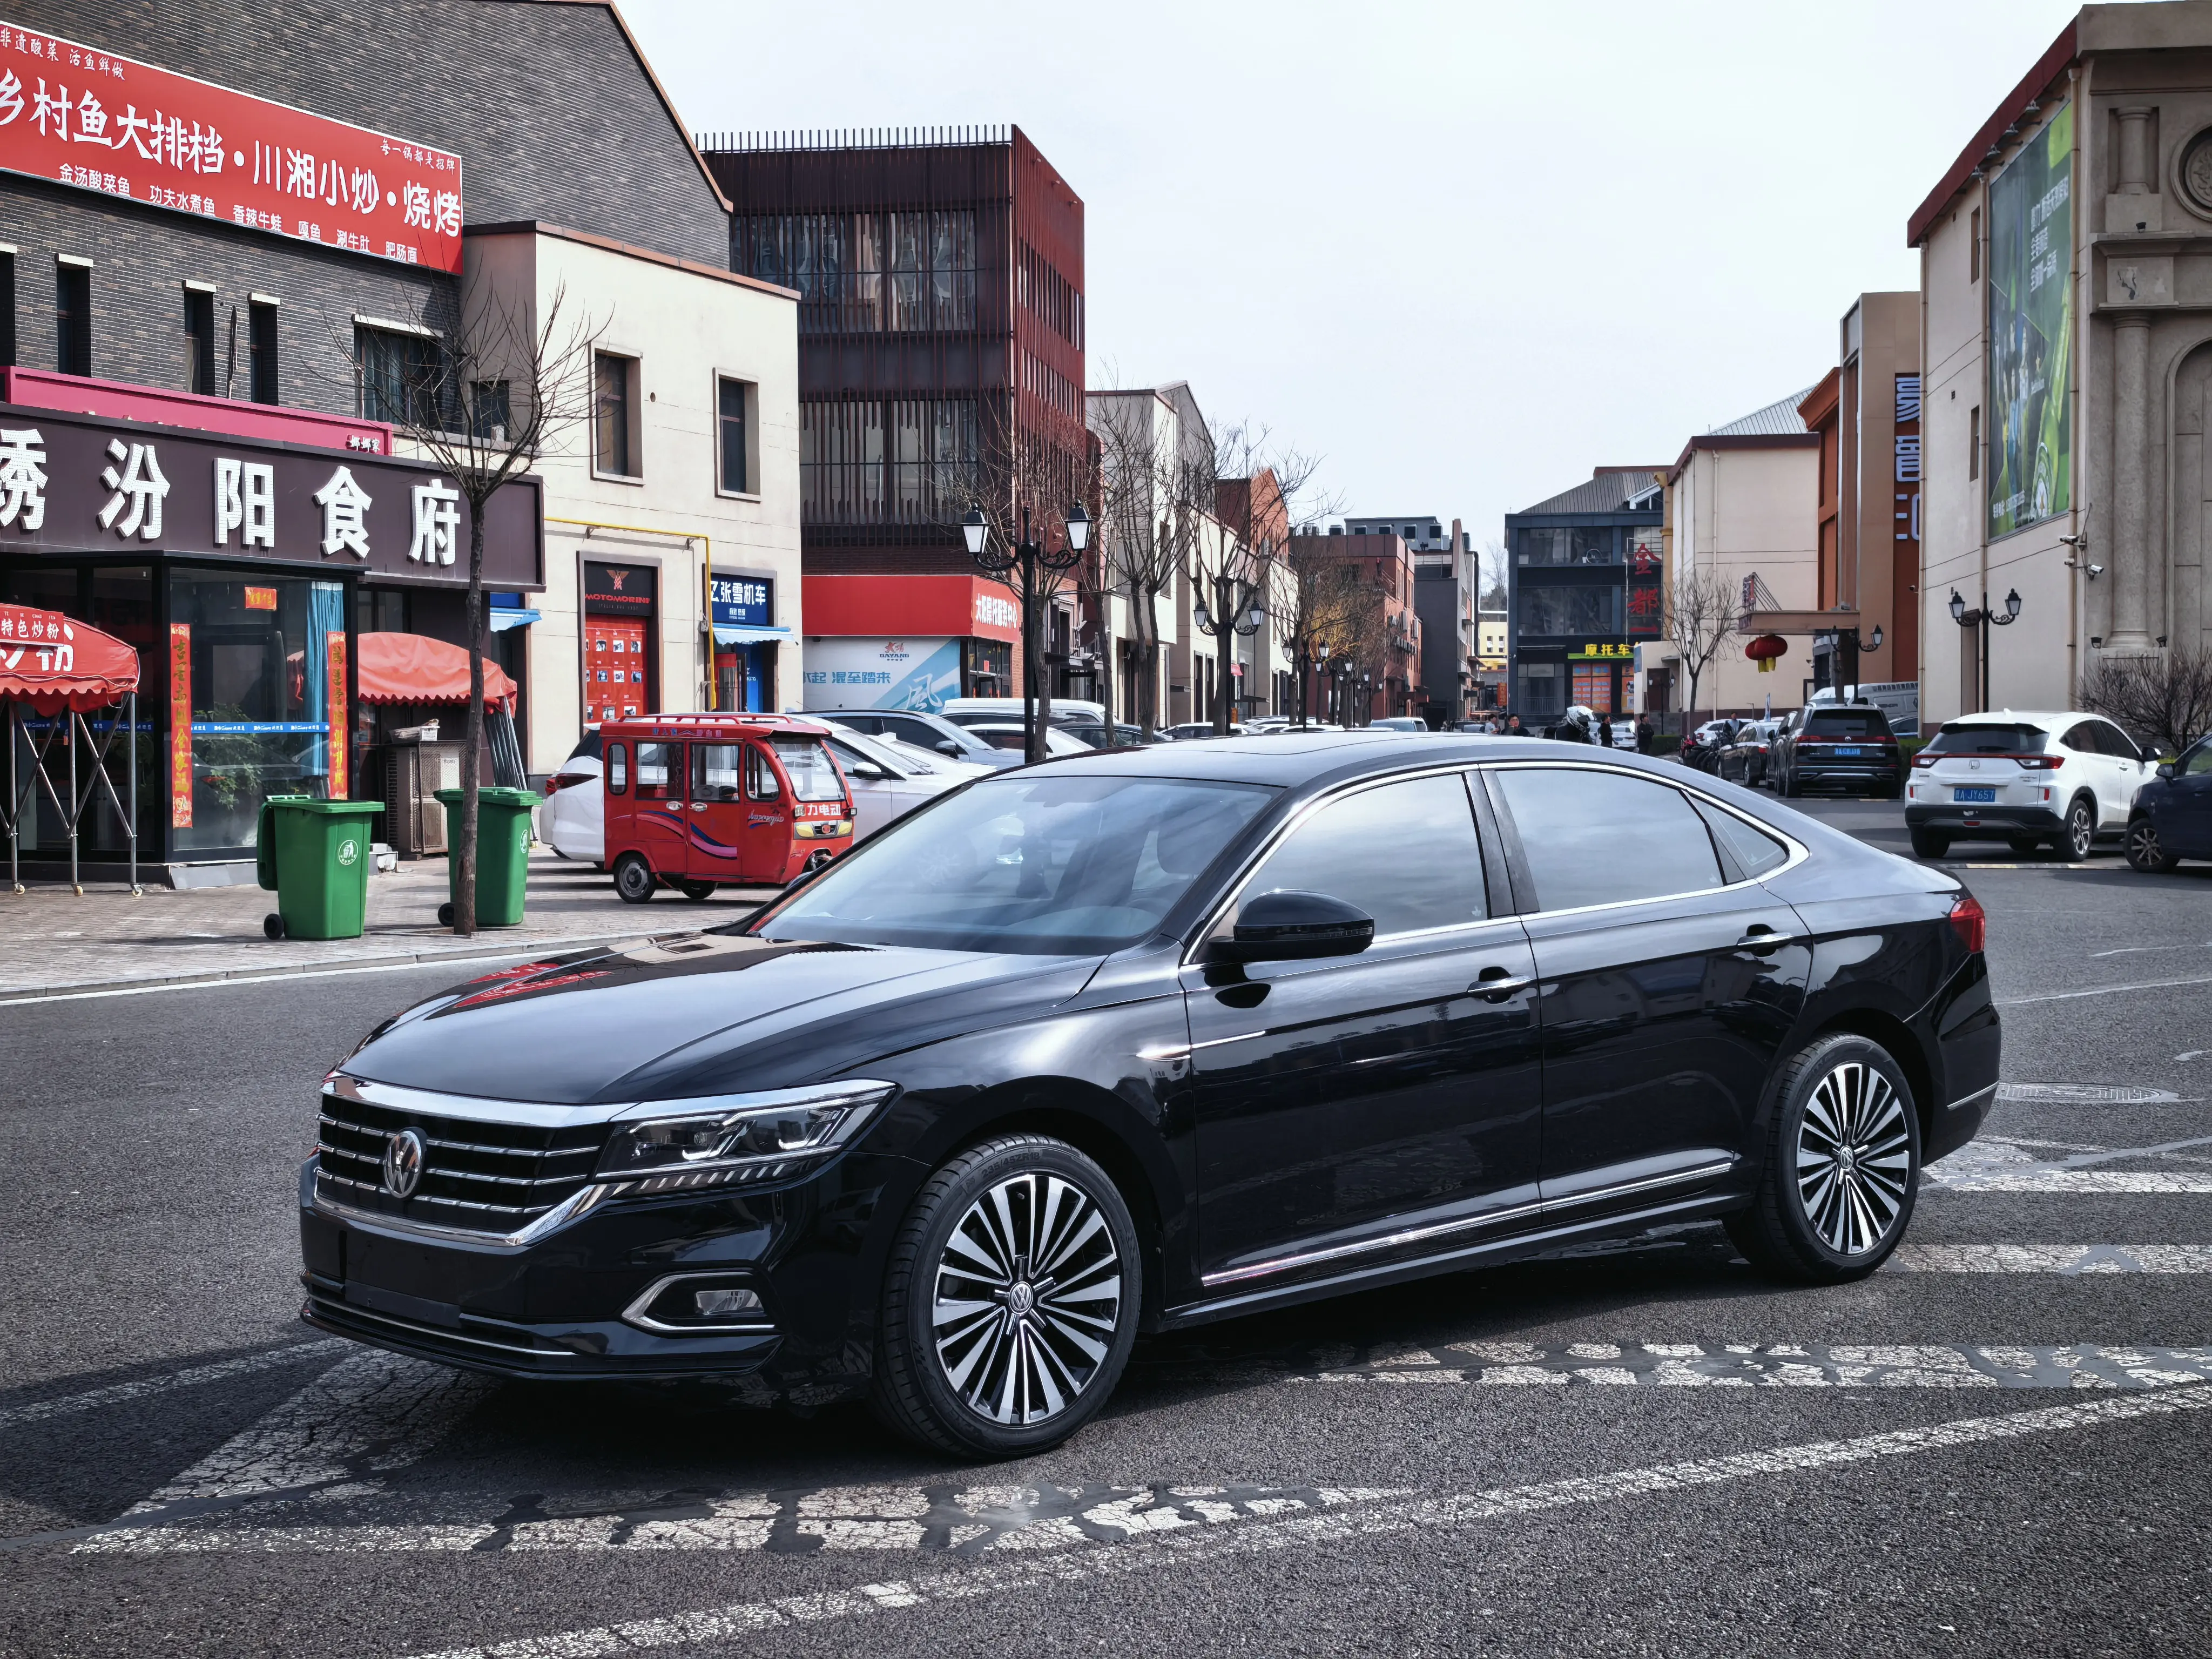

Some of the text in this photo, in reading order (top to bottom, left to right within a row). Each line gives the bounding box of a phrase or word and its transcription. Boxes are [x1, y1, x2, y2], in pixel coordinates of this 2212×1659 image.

[69, 48, 125, 80] 活鱼鲜做
[380, 138, 455, 175] 每一锅都是招牌
[59, 163, 130, 197] 金汤酸菜鱼
[150, 185, 215, 217] 功夫水煮鱼
[233, 205, 282, 232] 香辣牛蛙
[1, 618, 59, 640] 特色炒粉
[1585, 642, 1640, 657] 摩托车
